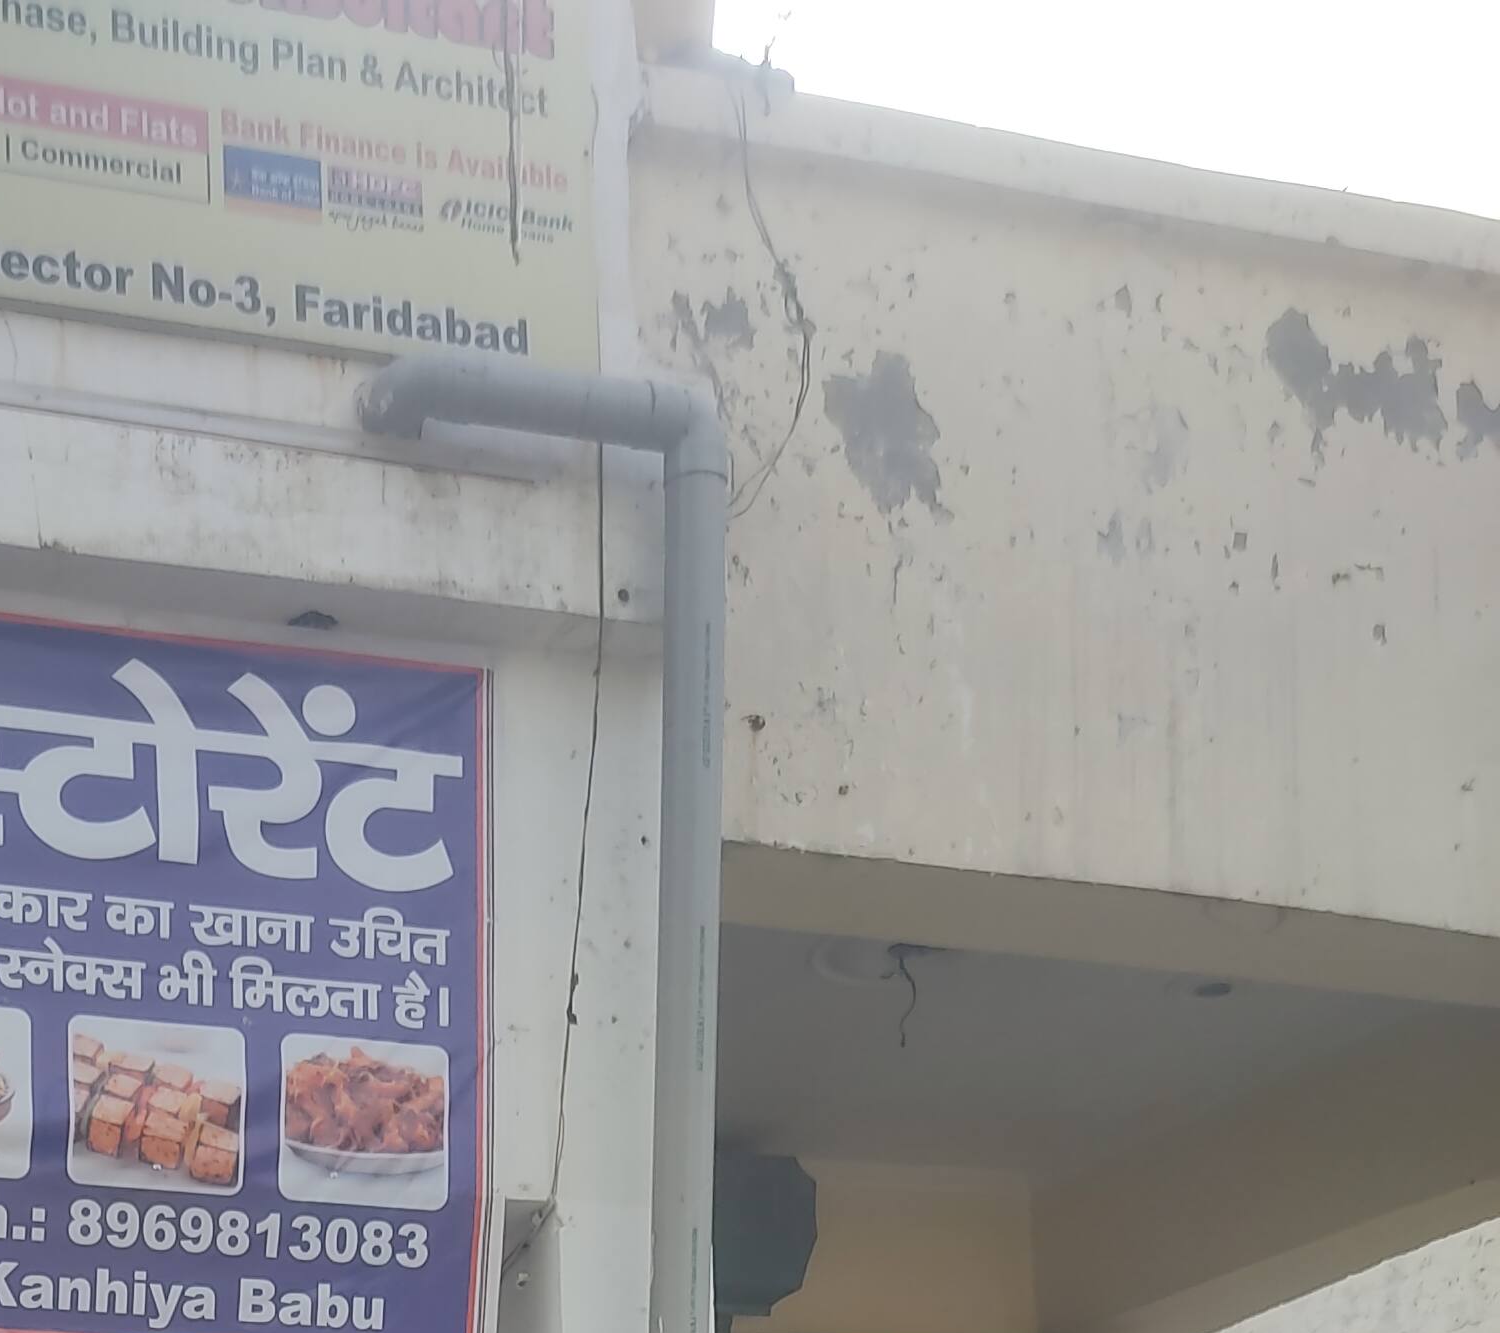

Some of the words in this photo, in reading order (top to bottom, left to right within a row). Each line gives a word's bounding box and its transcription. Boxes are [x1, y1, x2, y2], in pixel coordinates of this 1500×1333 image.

[110, 9, 259, 75] Building
[271, 38, 347, 82] Plan
[359, 53, 385, 90] &
[49, 102, 110, 133] and
[120, 109, 199, 147] Flats
[221, 109, 290, 145] Bank
[300, 123, 406, 166] Finance
[448, 149, 568, 194] Avaible
[21, 139, 182, 185] Commercial
[465, 198, 509, 222] ICIC
[151, 260, 278, 327] No-3,
[293, 283, 530, 356] Faridabad
[104, 895, 174, 939] का
[188, 903, 315, 954] खाना
[328, 906, 450, 966] उचित
[158, 950, 218, 1008] भी
[229, 955, 382, 1021] मिलता
[66, 1199, 430, 1269] 8969813083
[237, 1278, 385, 1331] Babu
